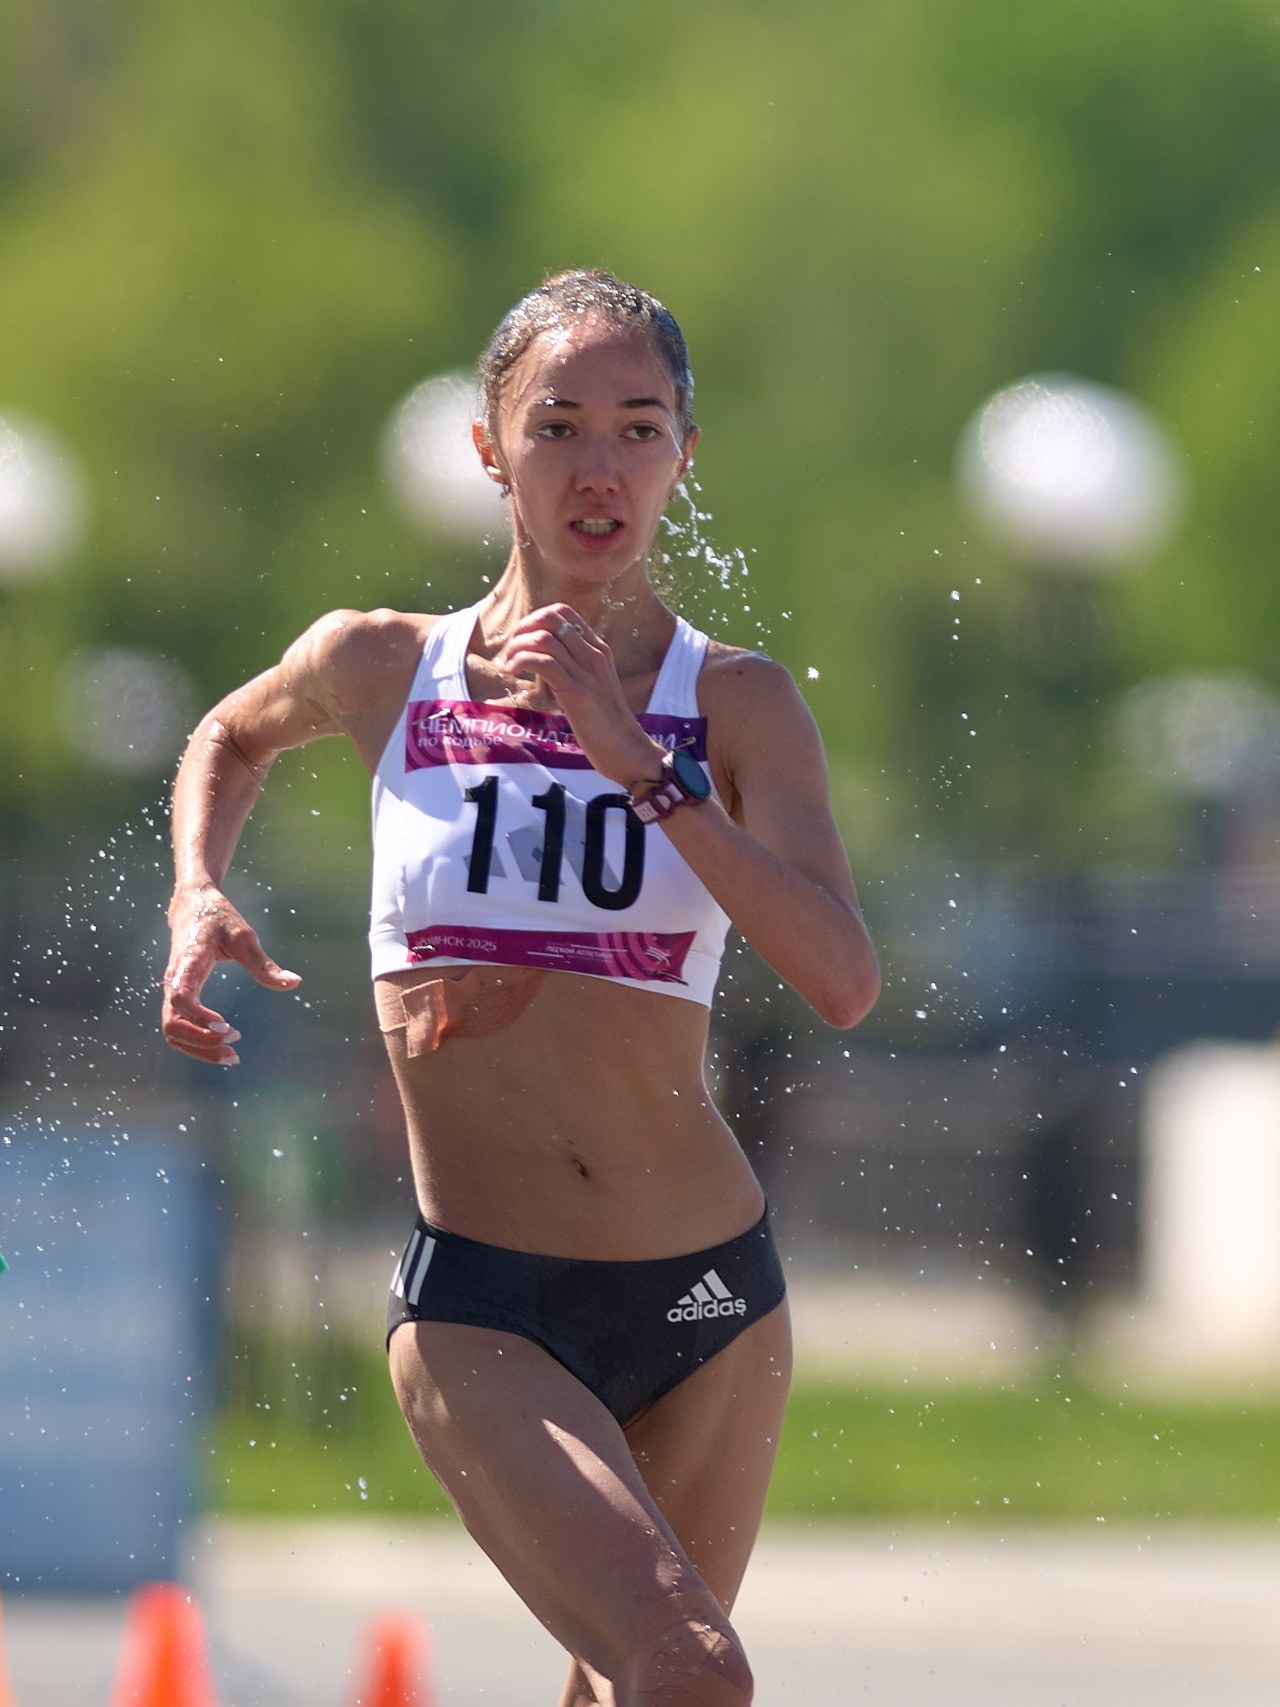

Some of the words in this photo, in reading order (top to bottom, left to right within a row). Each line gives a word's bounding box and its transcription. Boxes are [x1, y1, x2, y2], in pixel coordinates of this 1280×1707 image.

[464, 776, 646, 911] 110
[467, 937, 497, 953] 2025
[666, 1298, 747, 1323] adidas
